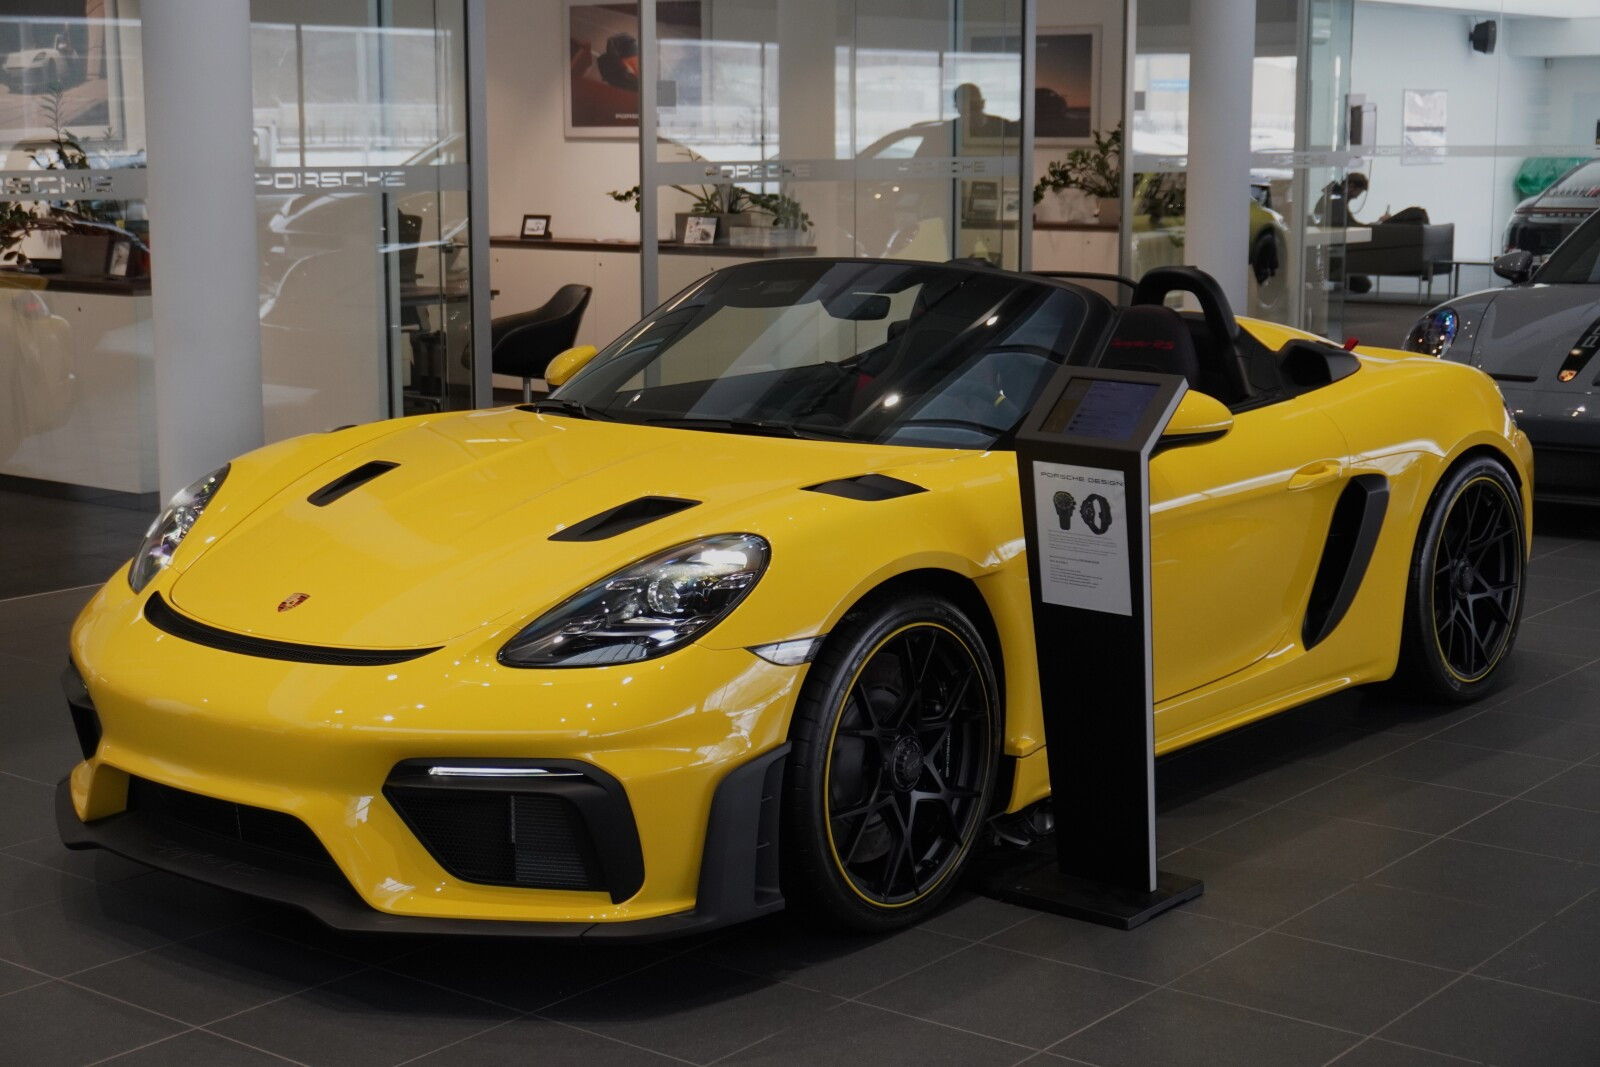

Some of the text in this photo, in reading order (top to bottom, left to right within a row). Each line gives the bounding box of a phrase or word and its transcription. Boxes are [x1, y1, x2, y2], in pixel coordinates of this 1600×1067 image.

[0, 176, 113, 195] SCHE
[254, 171, 406, 189] PORSCHE
[1040, 471, 1123, 487] PORSCHE DESIGN
